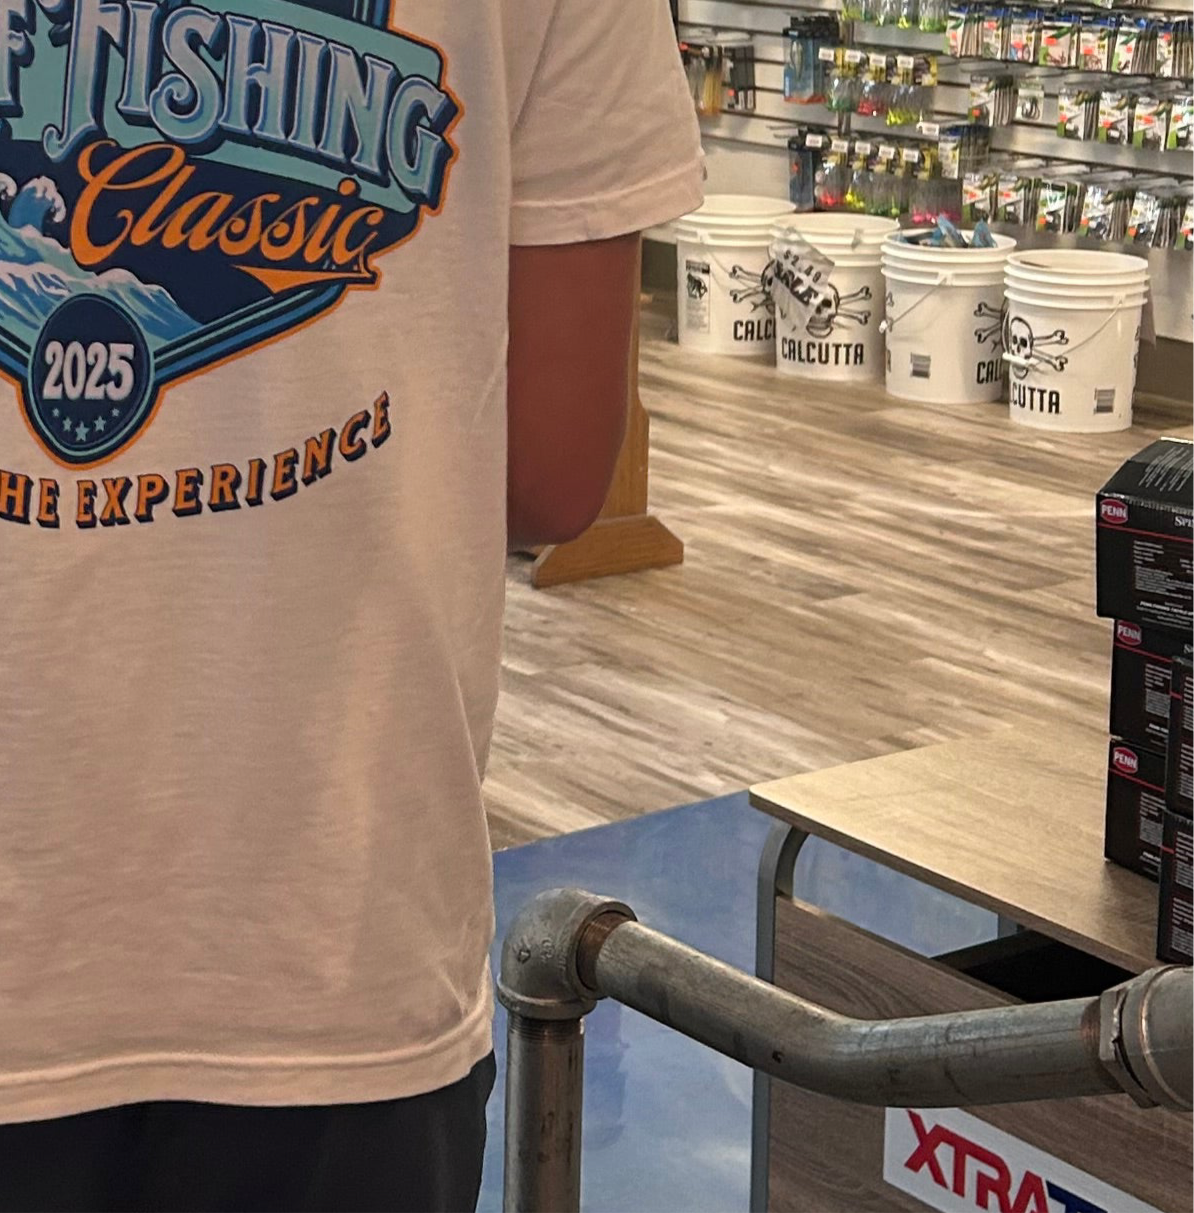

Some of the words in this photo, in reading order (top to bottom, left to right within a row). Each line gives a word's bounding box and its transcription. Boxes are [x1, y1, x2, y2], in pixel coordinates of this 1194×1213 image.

[69, 139, 383, 268] Classic
[733, 318, 776, 341] CALC
[781, 337, 864, 365] CALCUTTA
[43, 341, 135, 401] 2025
[976, 358, 1004, 384] CAL
[76, 391, 392, 529] EXPERIENCE
[1101, 504, 1127, 519] PENN
[1117, 624, 1141, 640] PENN
[1114, 751, 1138, 769] PENN
